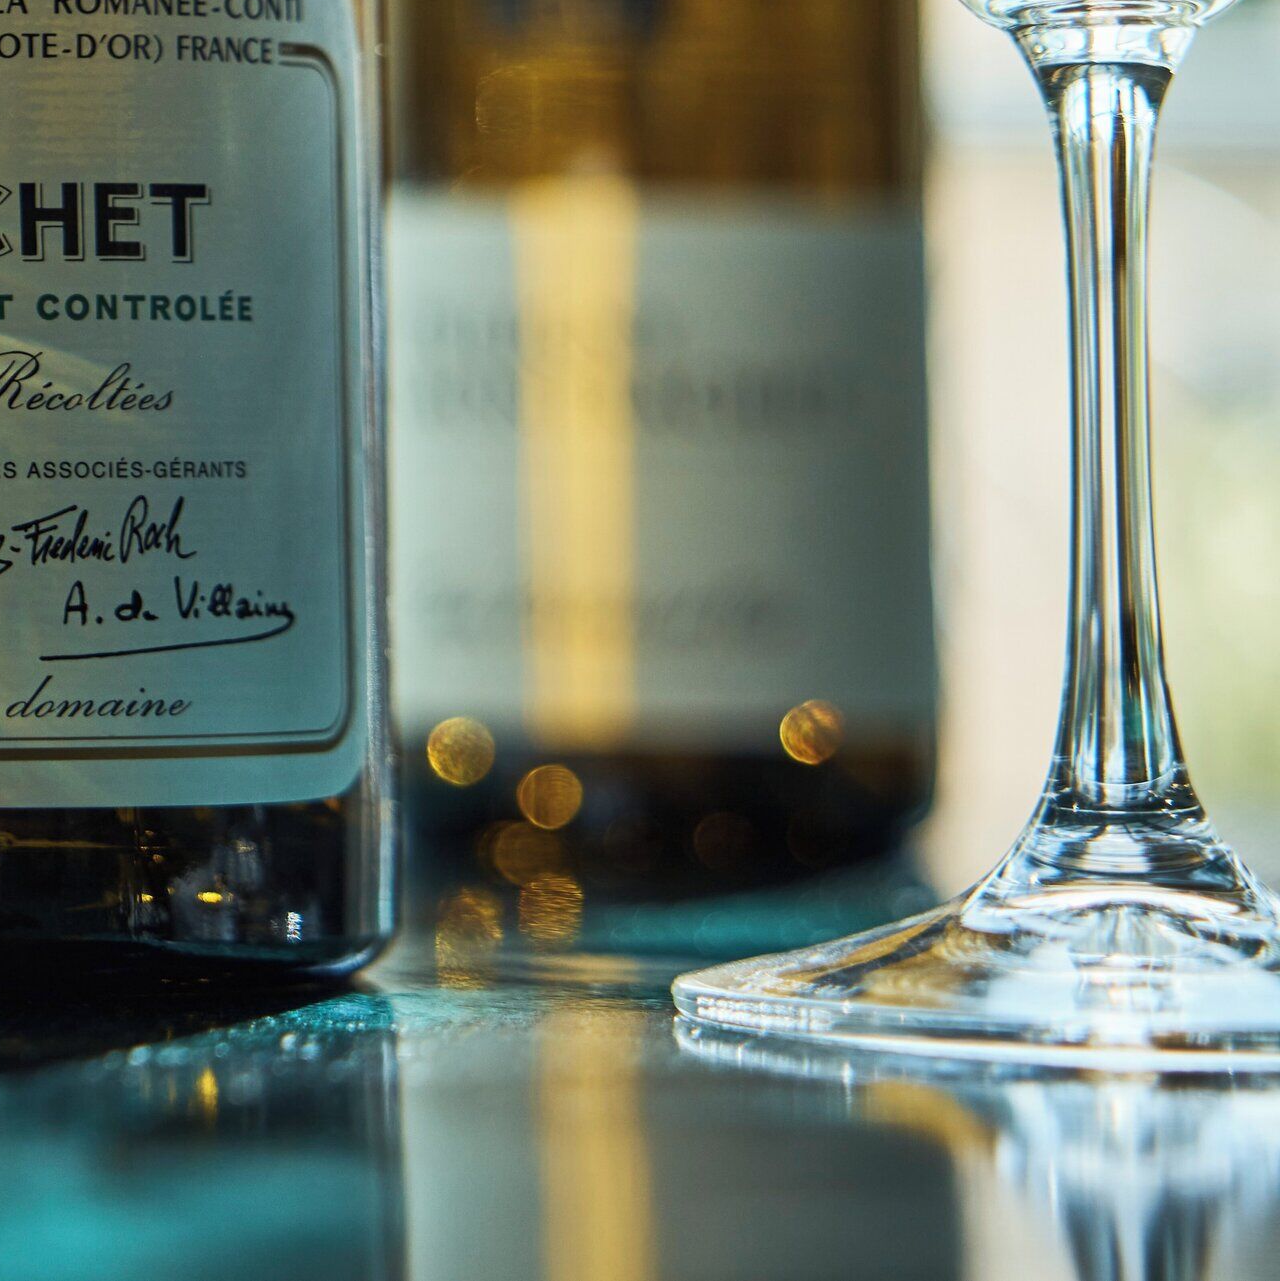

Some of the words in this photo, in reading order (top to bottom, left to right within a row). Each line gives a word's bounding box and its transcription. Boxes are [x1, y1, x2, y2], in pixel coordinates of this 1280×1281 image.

[176, 35, 272, 64] FRANCE
[36, 289, 253, 321] CONTROLÉE
[27, 458, 247, 480] ASSOCIÉS-GÉRANTS
[6, 675, 192, 719] domaine
